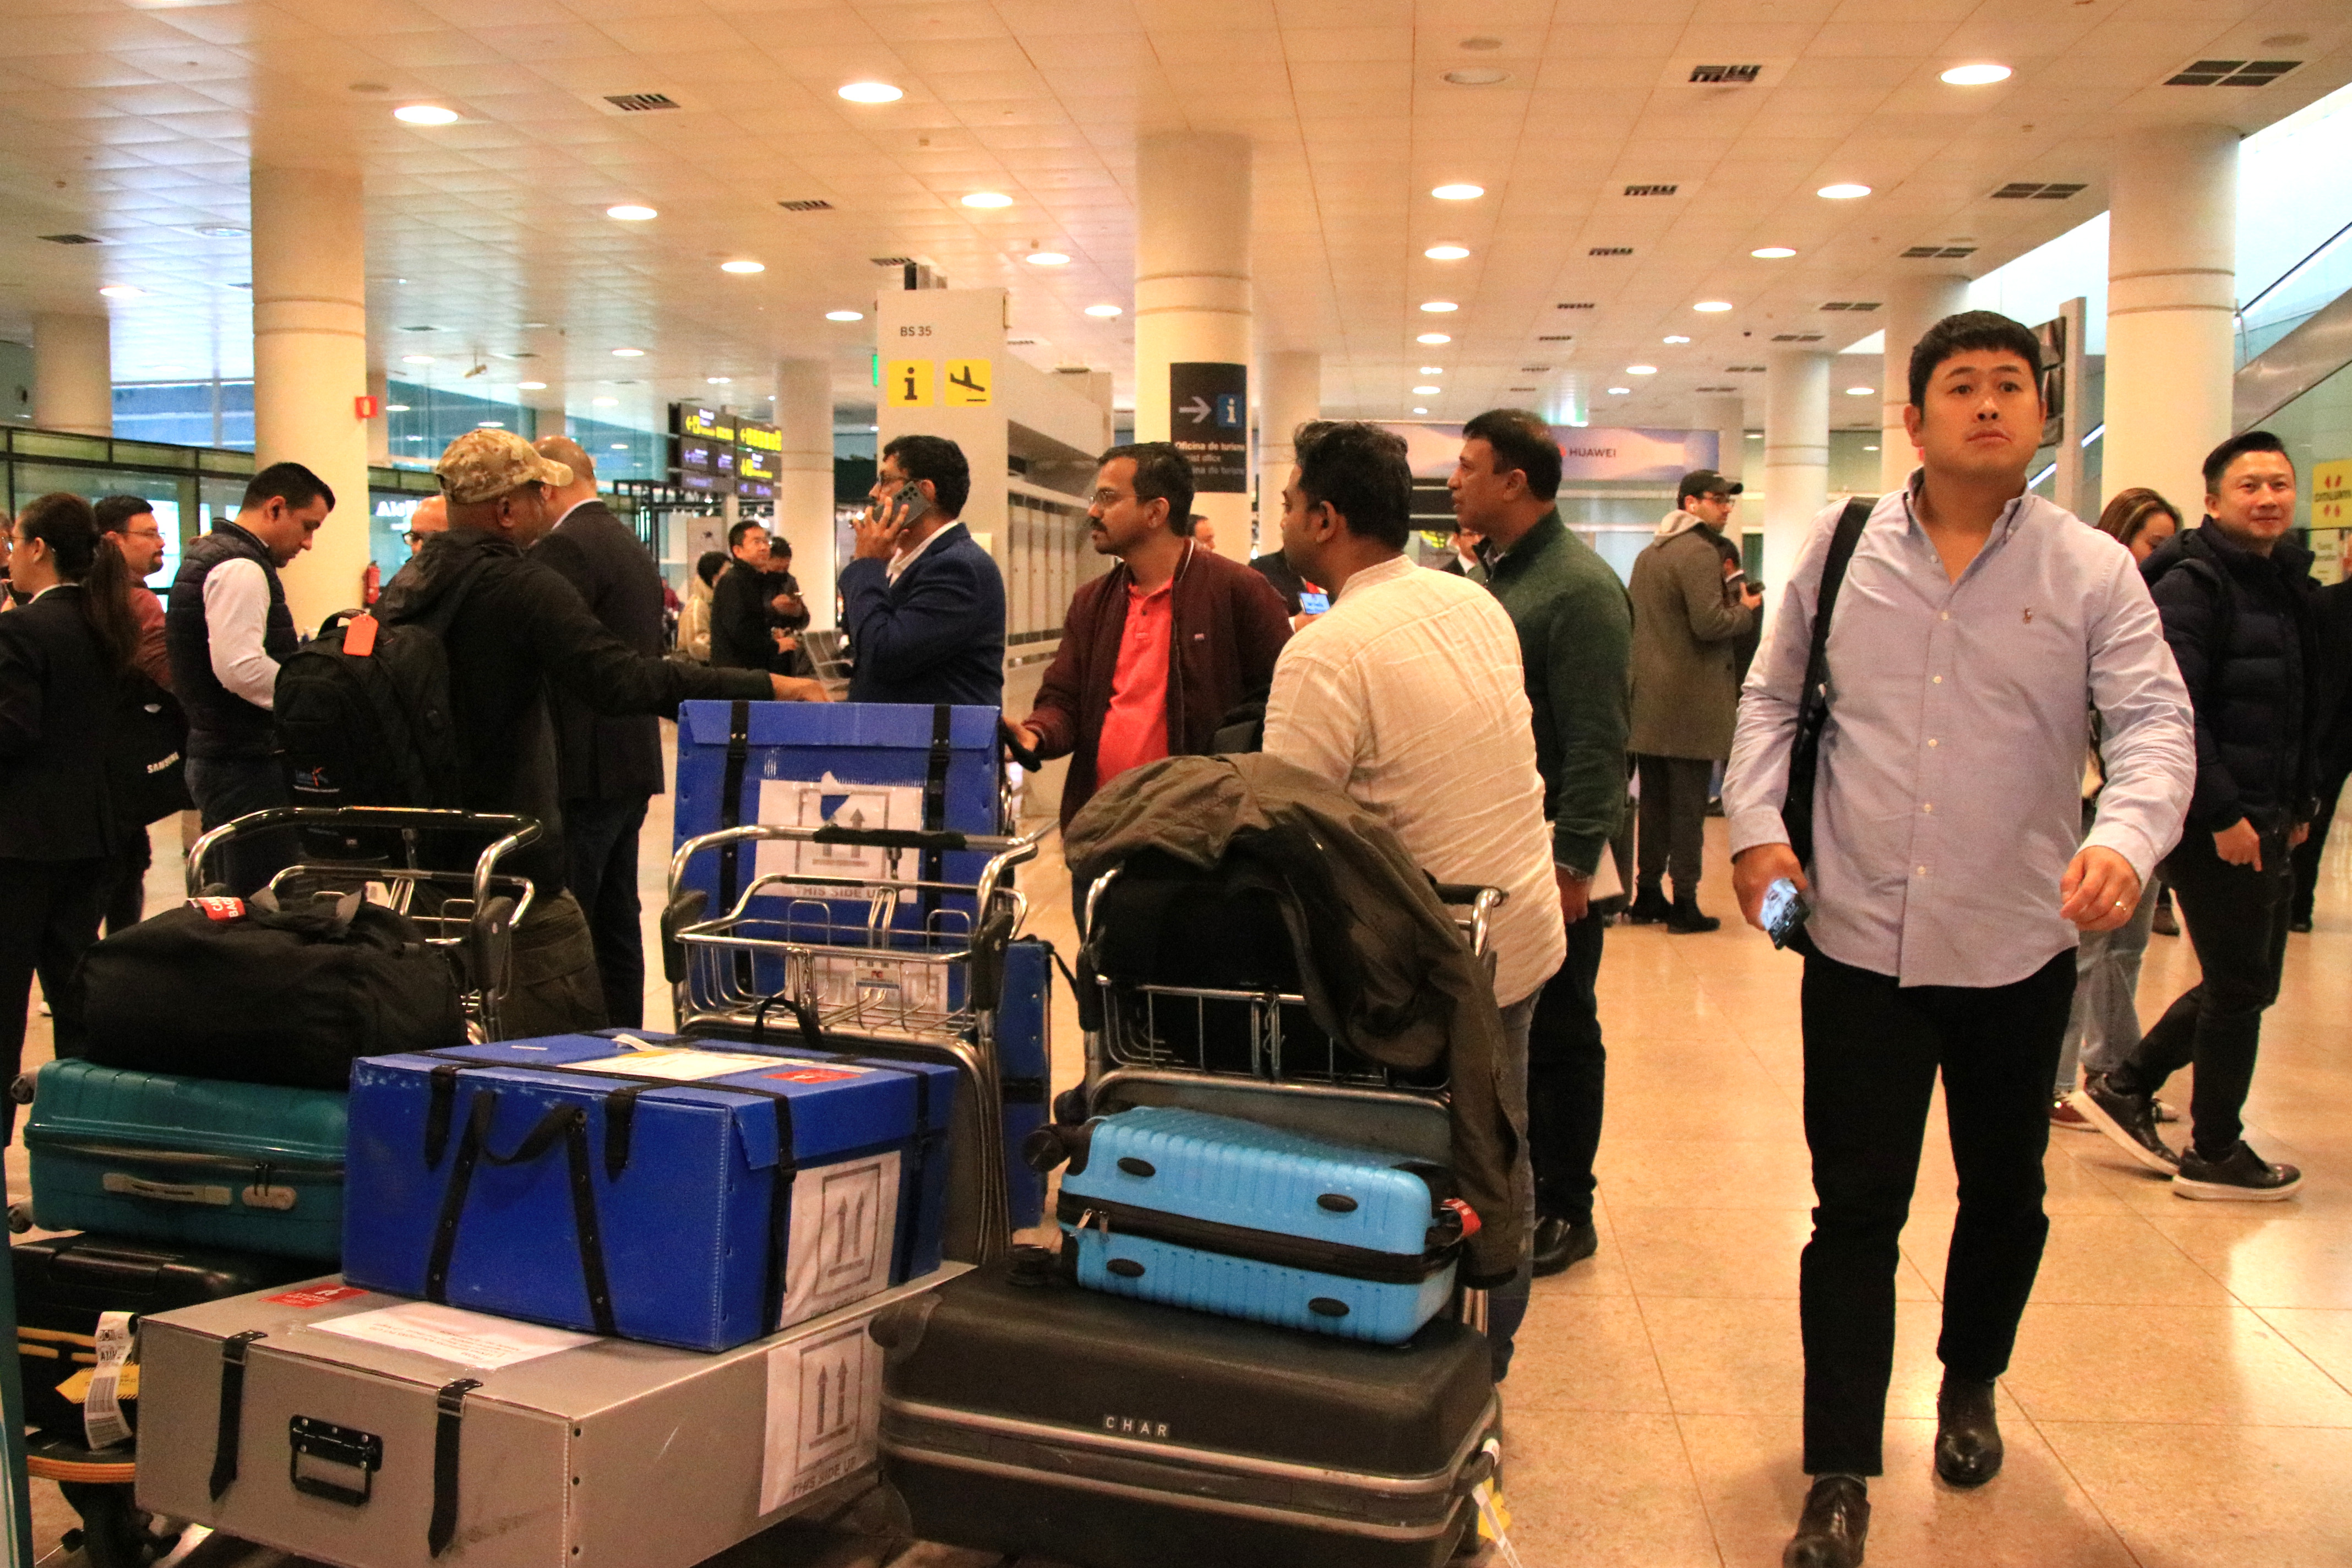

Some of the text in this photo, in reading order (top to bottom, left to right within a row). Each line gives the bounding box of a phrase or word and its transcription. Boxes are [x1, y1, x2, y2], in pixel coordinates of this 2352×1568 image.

[900, 325, 932, 336] BS 35
[1569, 448, 1616, 458] HUAWEI
[1106, 1416, 1167, 1436] CHAR
